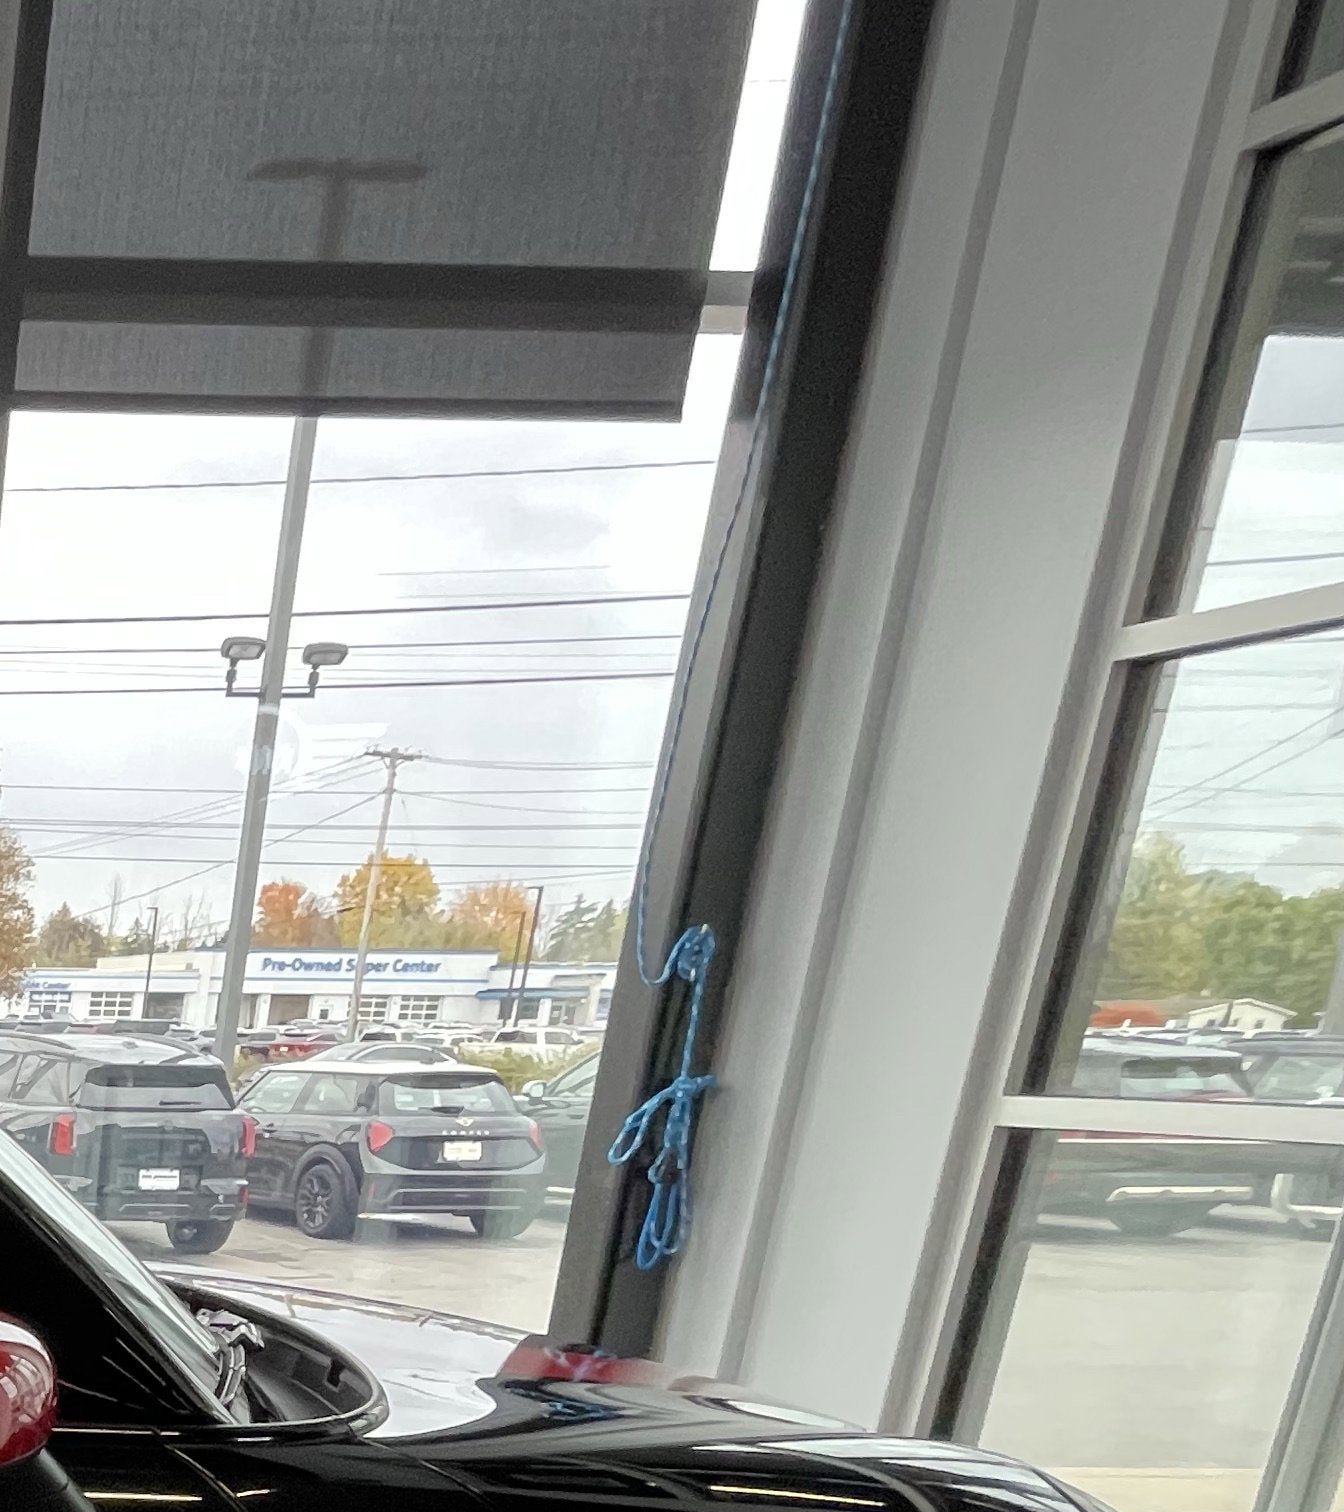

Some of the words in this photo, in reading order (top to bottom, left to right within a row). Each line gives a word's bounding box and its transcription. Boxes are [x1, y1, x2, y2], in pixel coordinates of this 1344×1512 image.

[261, 957, 342, 972] Pre-Owned
[345, 958, 389, 975] Sper
[393, 958, 442, 972] Center
